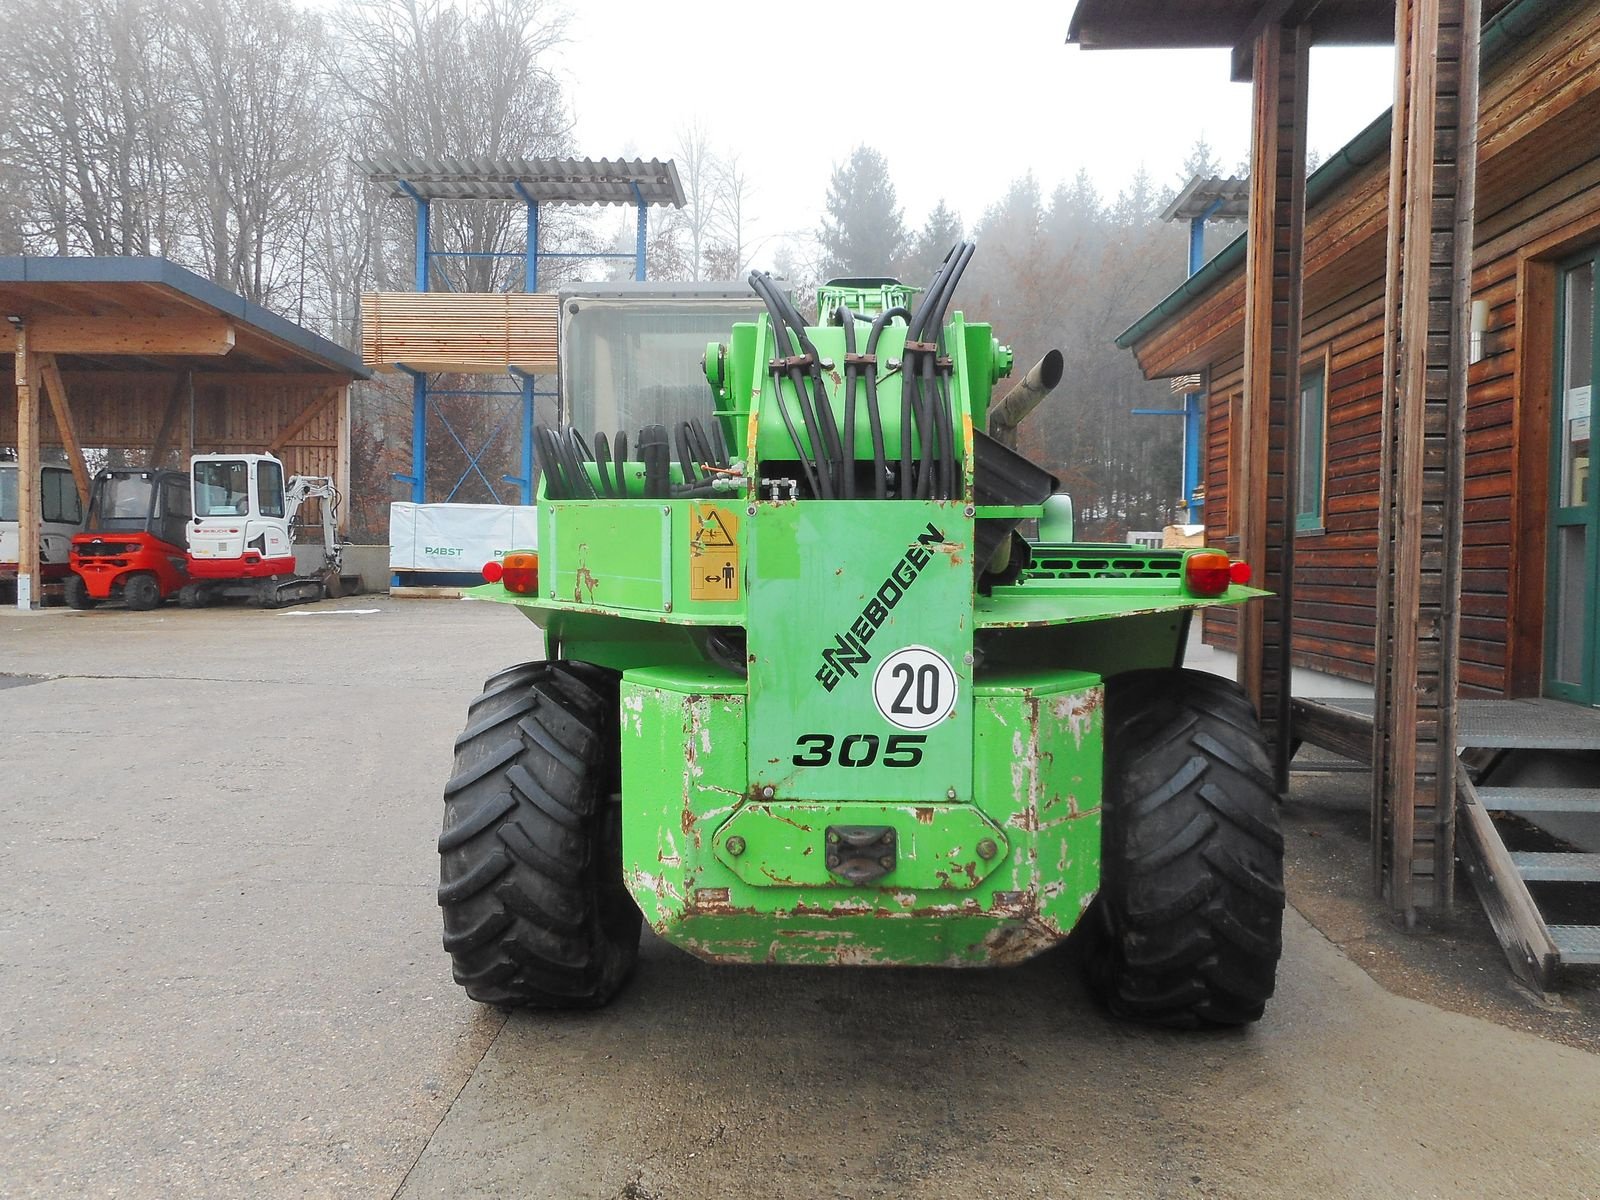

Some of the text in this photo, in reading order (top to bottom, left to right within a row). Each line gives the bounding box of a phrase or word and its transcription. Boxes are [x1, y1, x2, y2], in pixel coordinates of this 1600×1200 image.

[425, 547, 464, 556] PABST
[891, 663, 940, 714] 20
[792, 734, 927, 767] 305
